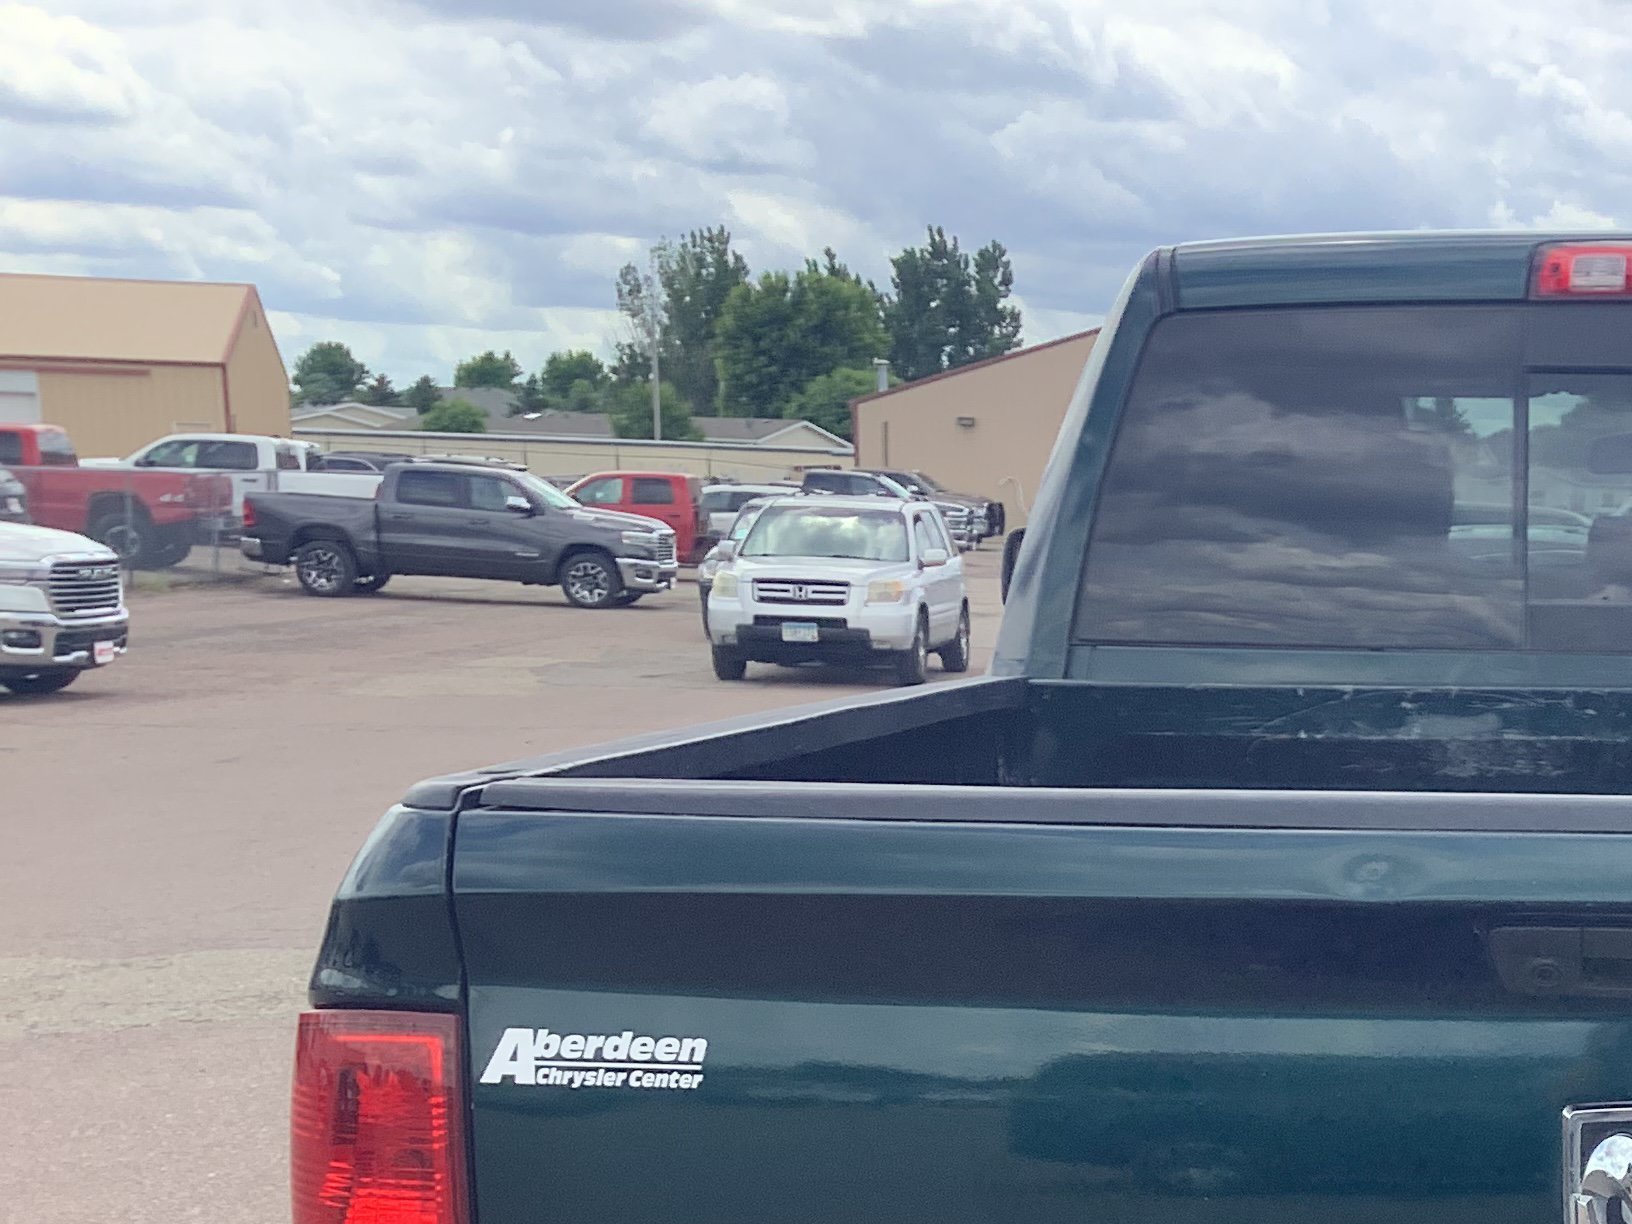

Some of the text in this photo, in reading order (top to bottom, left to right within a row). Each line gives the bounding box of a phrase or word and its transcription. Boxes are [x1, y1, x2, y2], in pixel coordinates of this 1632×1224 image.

[480, 1027, 708, 1085] Aberdeen
[536, 1067, 704, 1090] Chrysler Center
